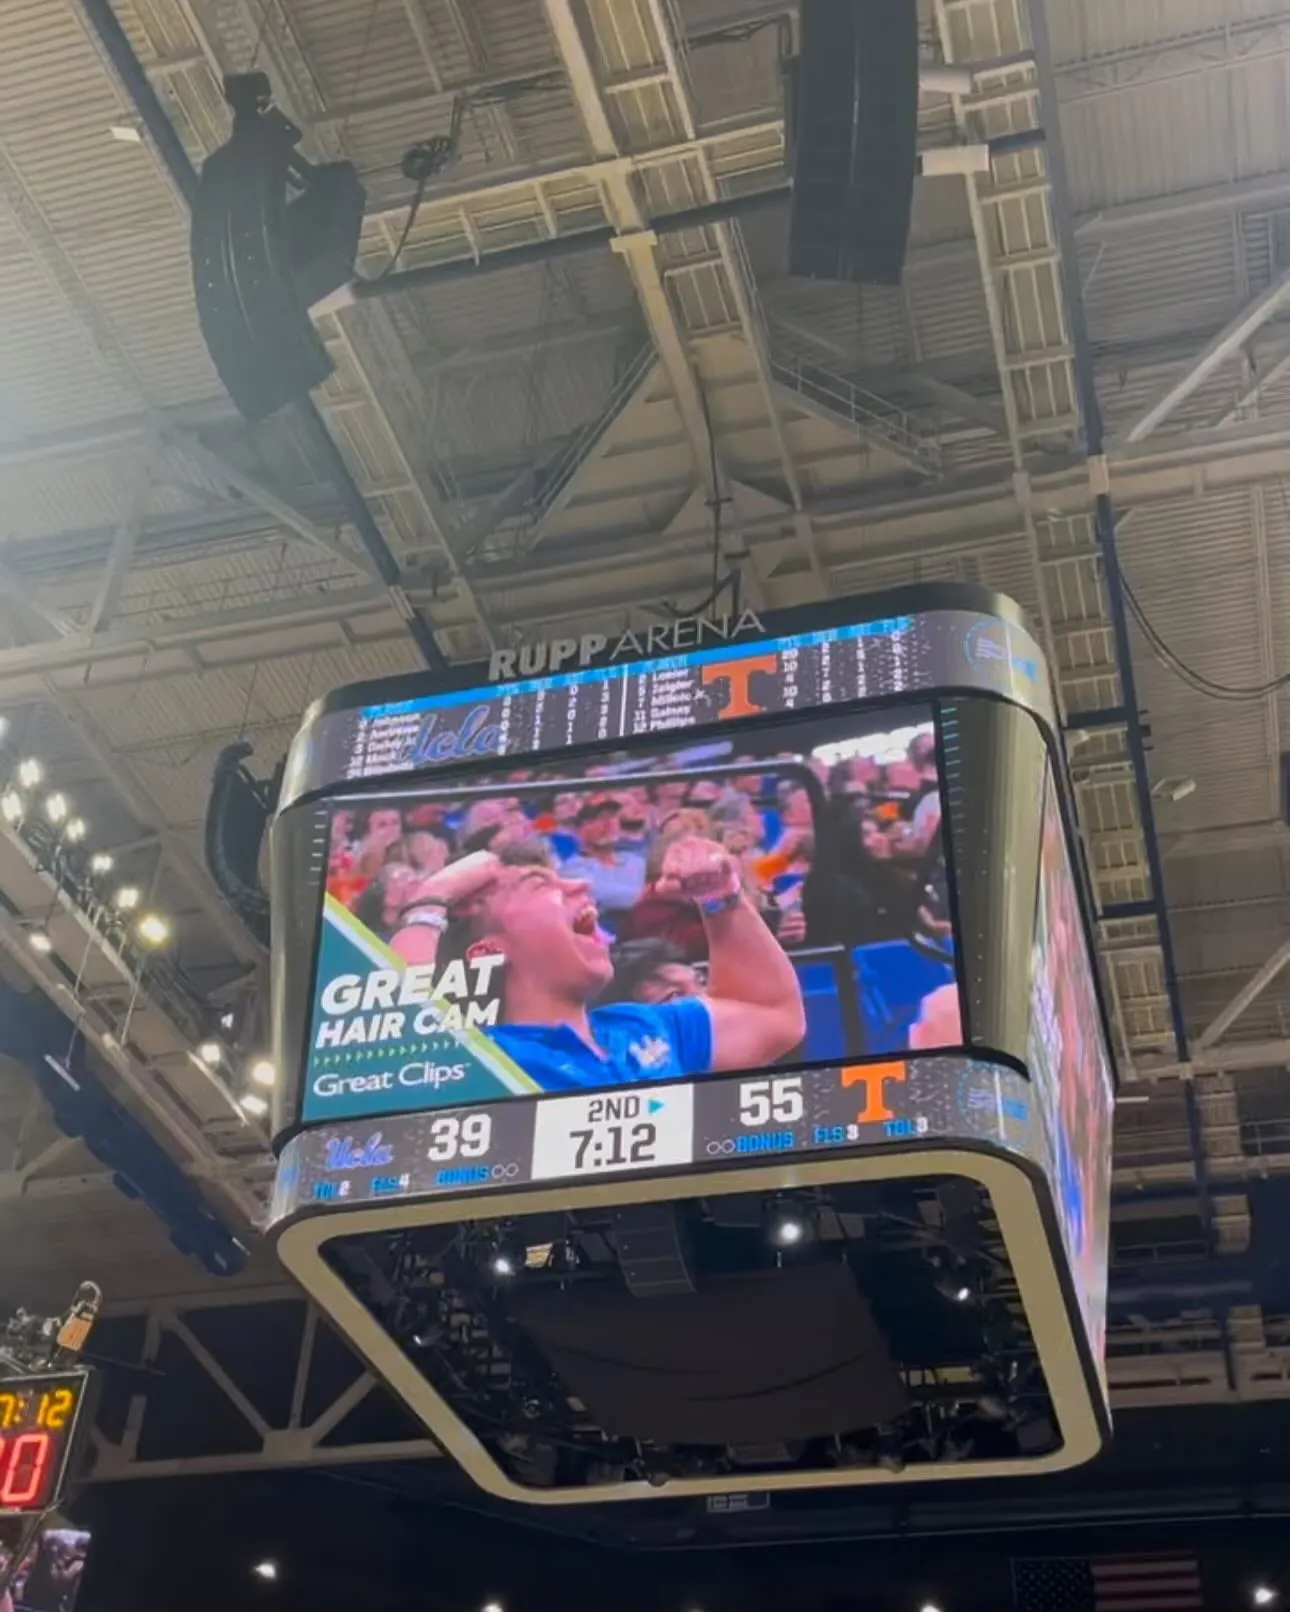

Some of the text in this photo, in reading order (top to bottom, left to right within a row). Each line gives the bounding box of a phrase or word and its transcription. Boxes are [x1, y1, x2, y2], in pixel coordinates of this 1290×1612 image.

[488, 608, 766, 681] RUPP ARENA
[321, 954, 506, 1015] GREAT
[315, 999, 500, 1048] HAIR CAM
[313, 1061, 466, 1097] Great Clips
[739, 1078, 803, 1127] 55
[841, 1061, 906, 1123] T
[587, 1095, 641, 1123] 2ND
[427, 1113, 492, 1161] 39
[569, 1123, 656, 1169] 7:12
[0, 1388, 73, 1429] 7:12
